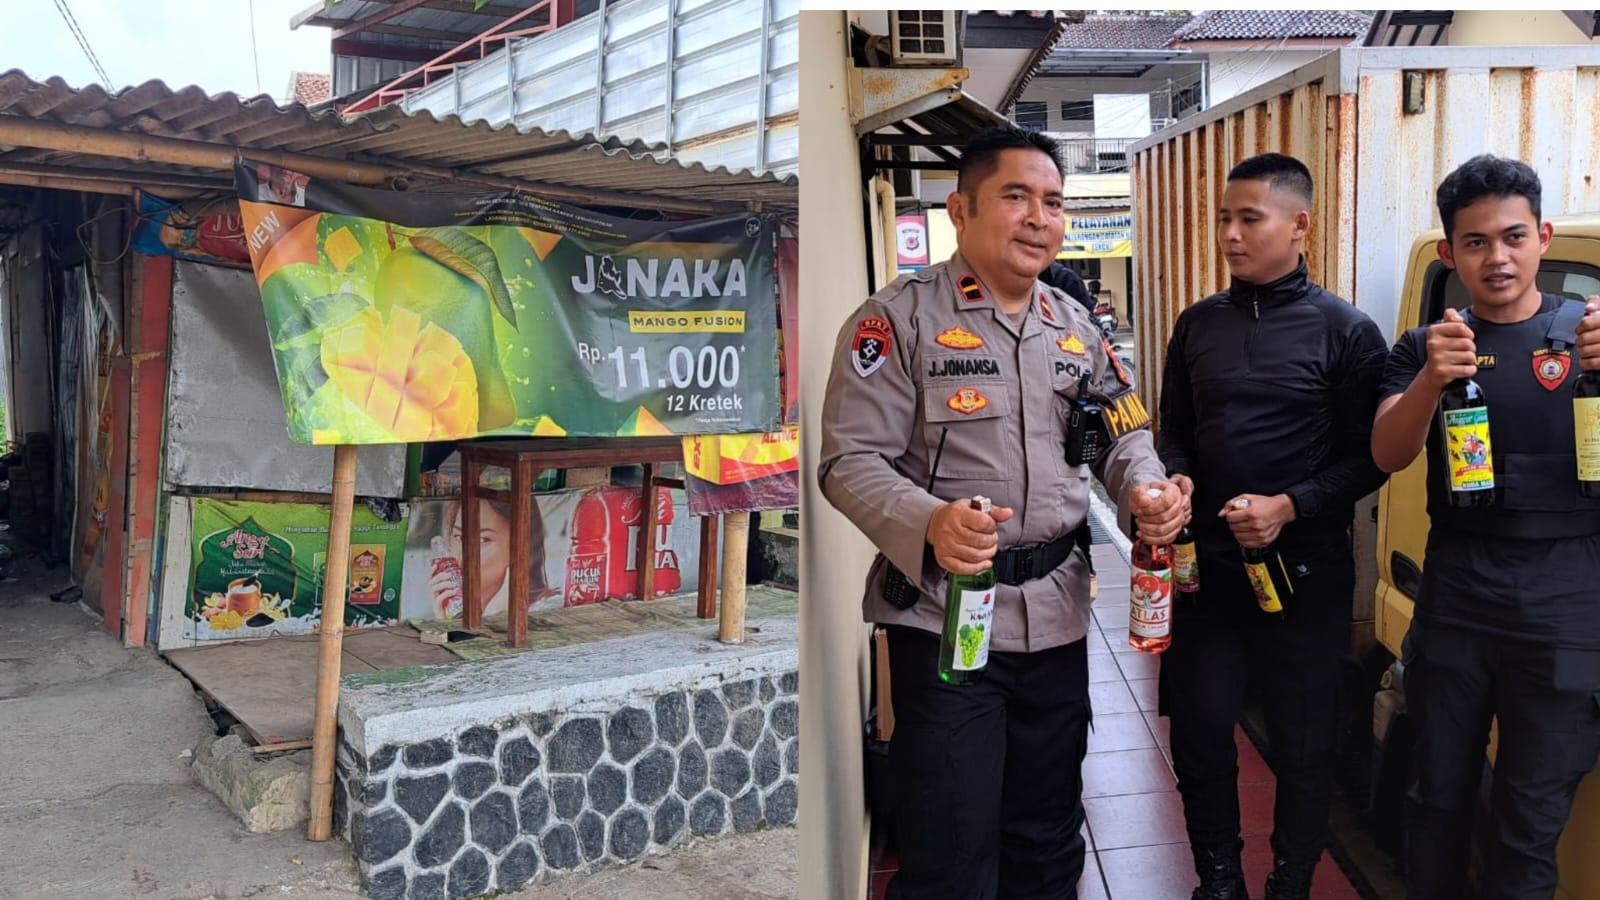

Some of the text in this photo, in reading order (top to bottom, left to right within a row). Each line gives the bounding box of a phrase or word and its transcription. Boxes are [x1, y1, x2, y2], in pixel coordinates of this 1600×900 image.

[250, 210, 281, 254] NEW
[633, 315, 743, 327] MANGO FUSION
[578, 341, 605, 365] Rp.
[929, 359, 999, 377] J.JONANSA
[667, 393, 743, 412] 12 Kretek
[1131, 605, 1167, 620] ATLAS
